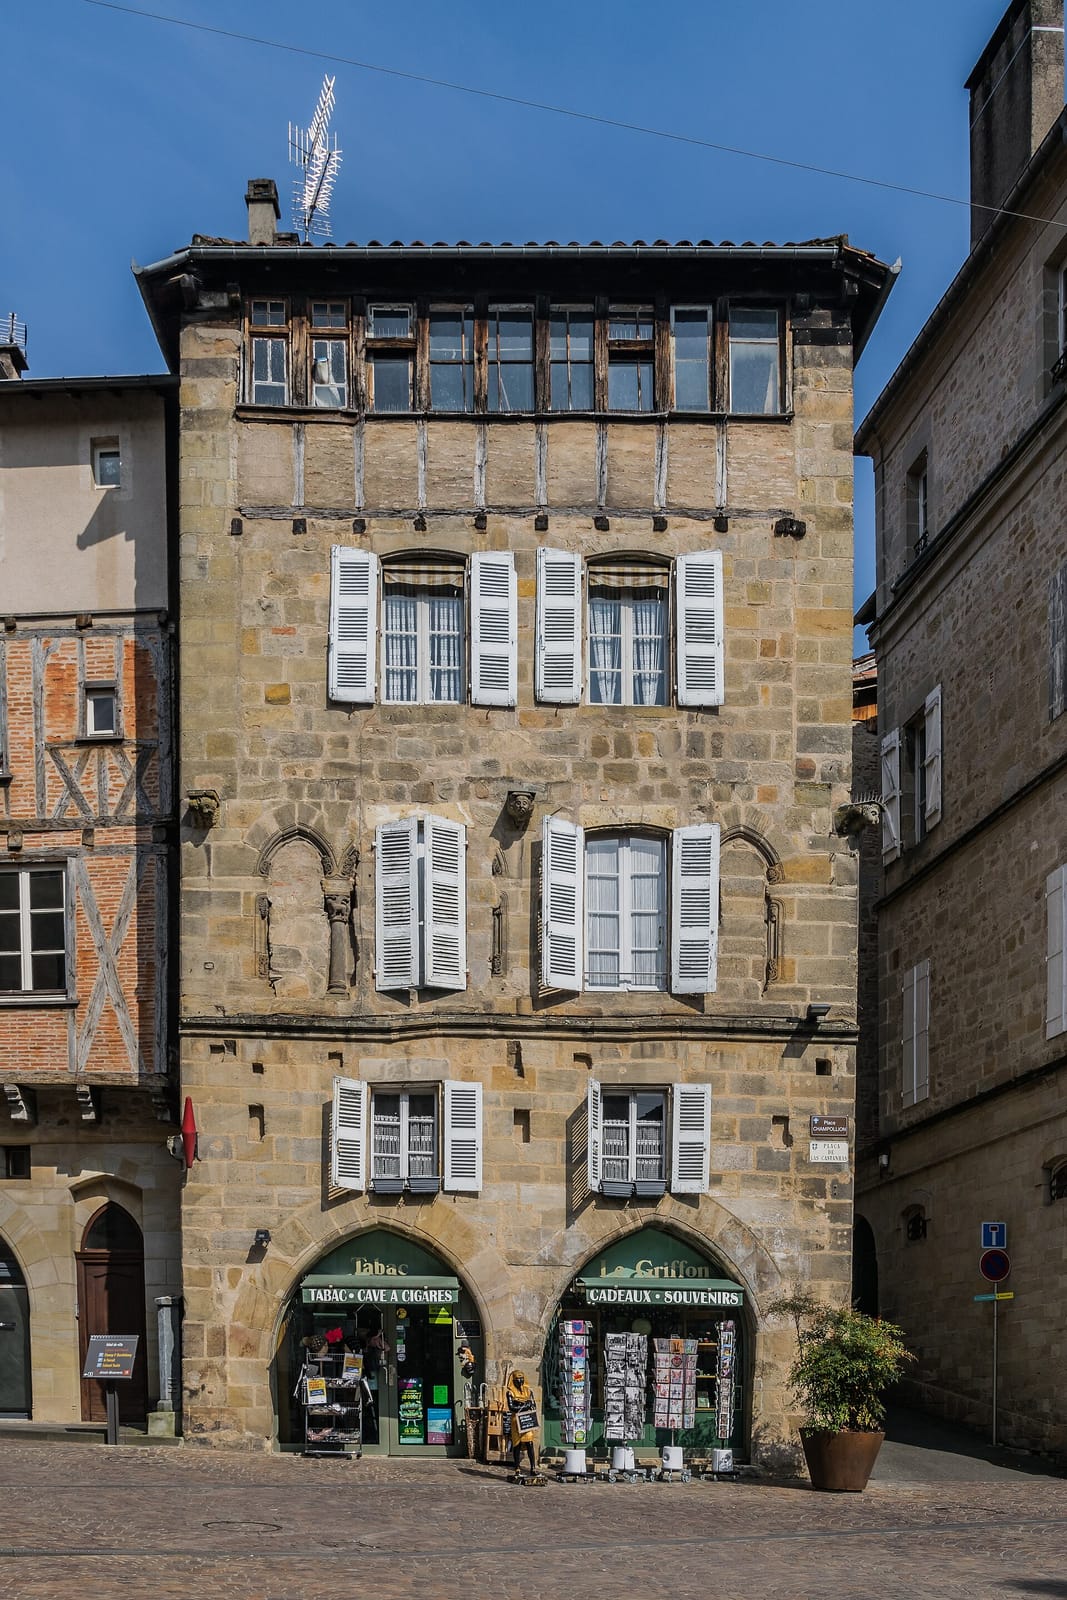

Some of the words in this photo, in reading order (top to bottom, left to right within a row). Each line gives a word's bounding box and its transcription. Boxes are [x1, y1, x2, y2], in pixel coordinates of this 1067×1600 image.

[351, 1256, 409, 1275] Tabac
[635, 1259, 710, 1278] Griffon
[309, 1288, 348, 1302] TABAC
[357, 1289, 388, 1302] CAVE
[402, 1289, 453, 1303] CIGARES
[589, 1288, 651, 1303] CADEAUX
[664, 1290, 739, 1305] SOUVENIRS
